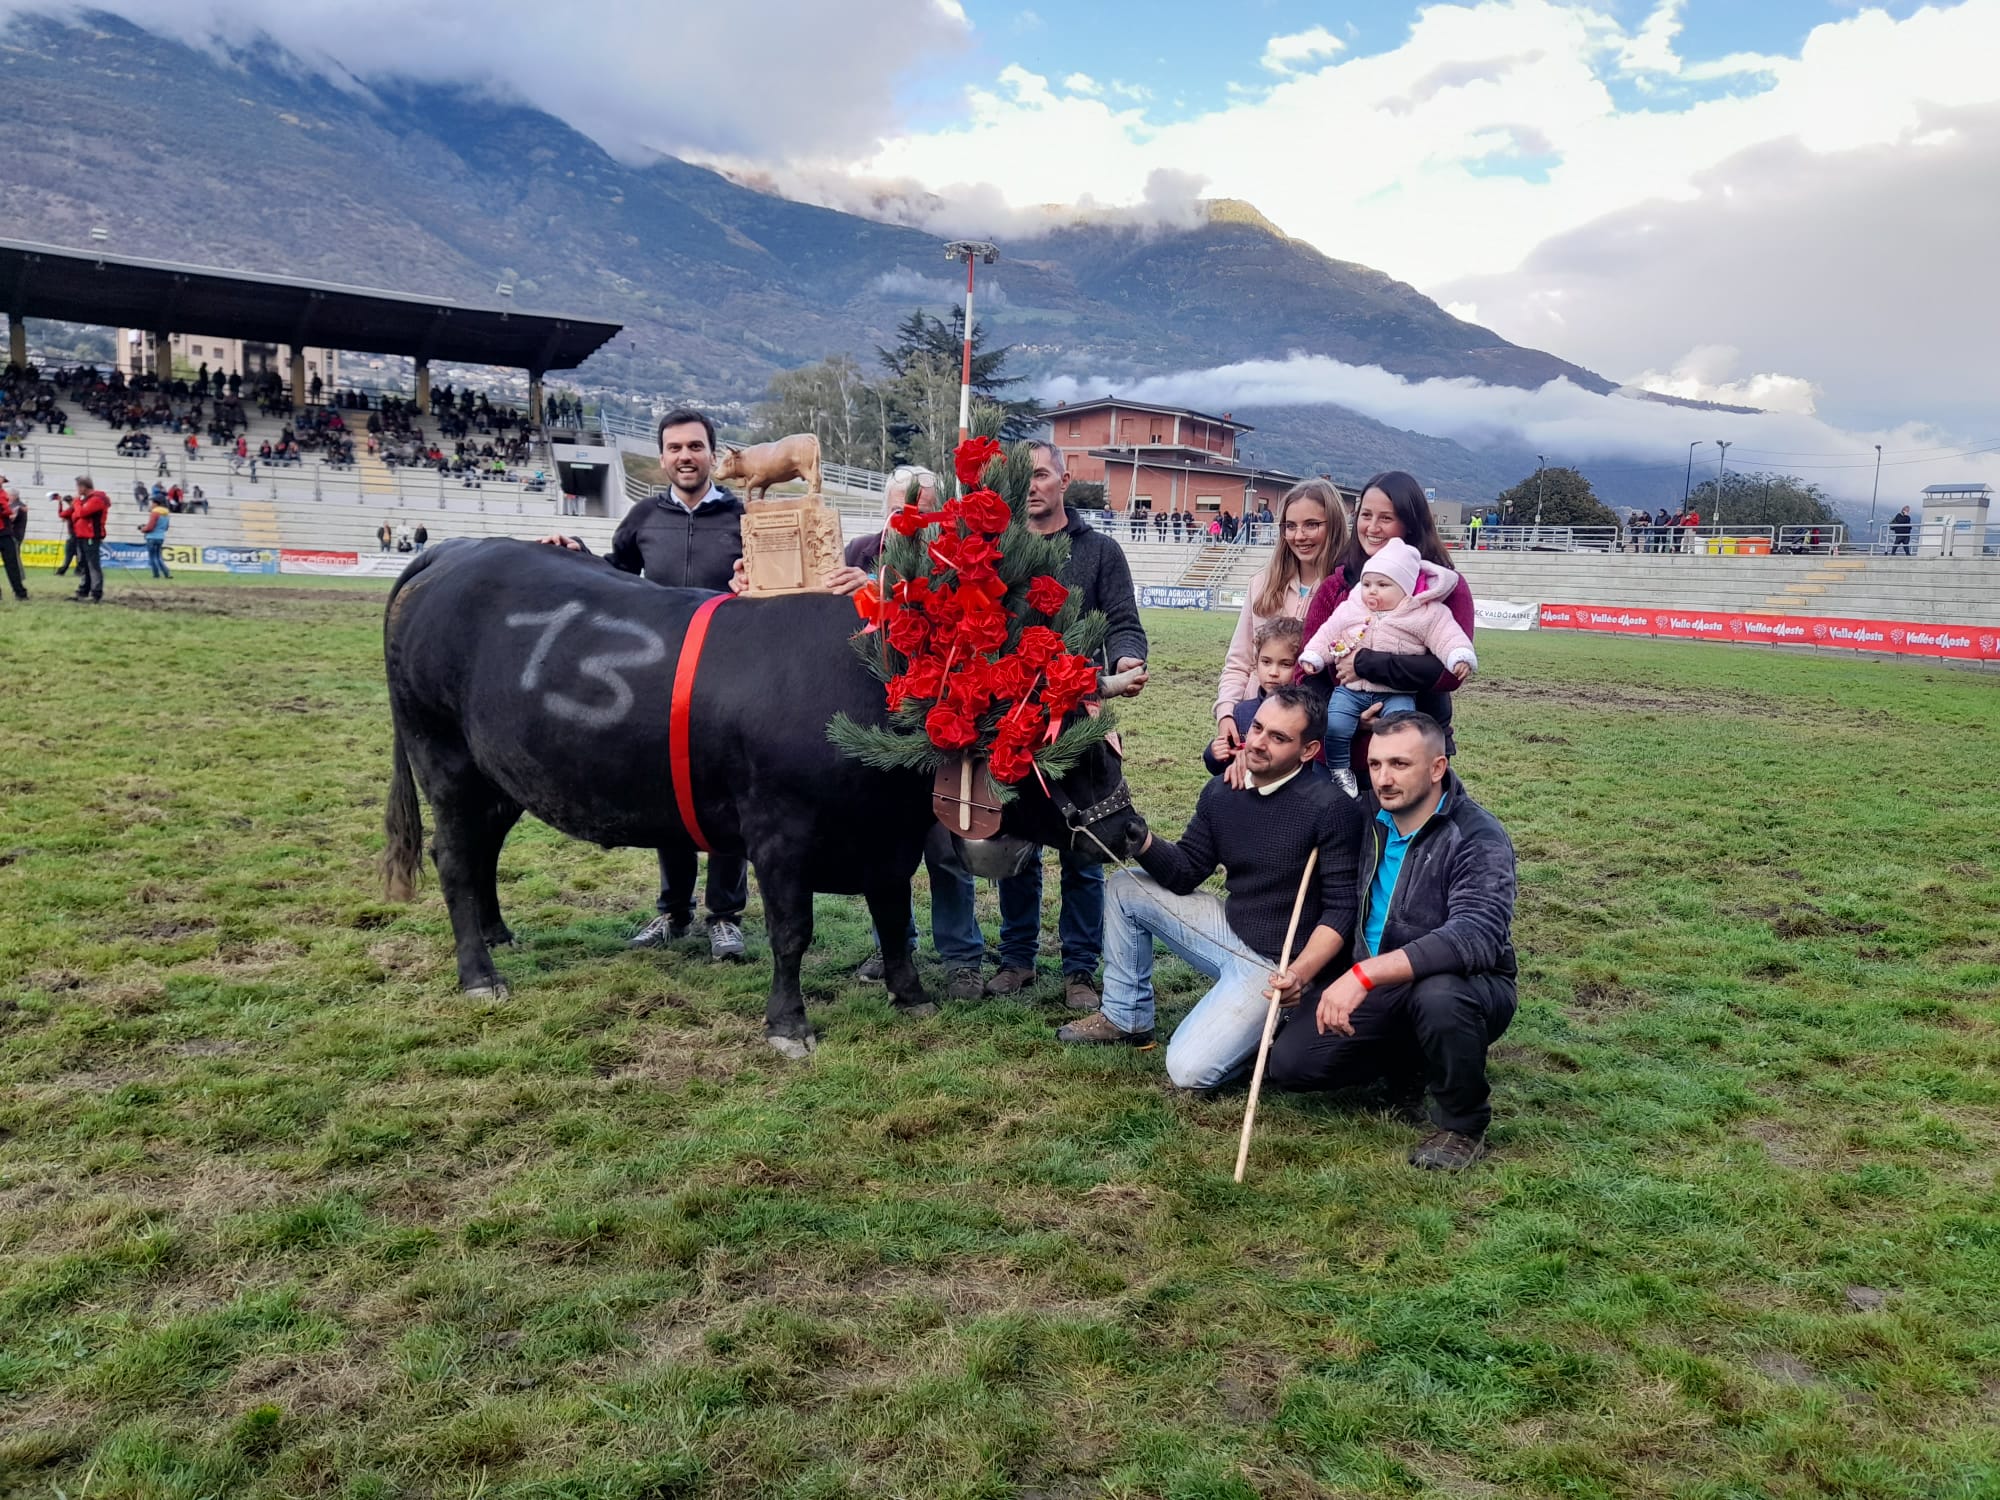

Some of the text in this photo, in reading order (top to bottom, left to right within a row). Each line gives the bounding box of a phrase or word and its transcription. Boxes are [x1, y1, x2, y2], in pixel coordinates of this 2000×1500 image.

[1143, 588, 1208, 598] CONFIDI AGRICOLTORI
[1153, 597, 1196, 606] VALLE D'AOSTA
